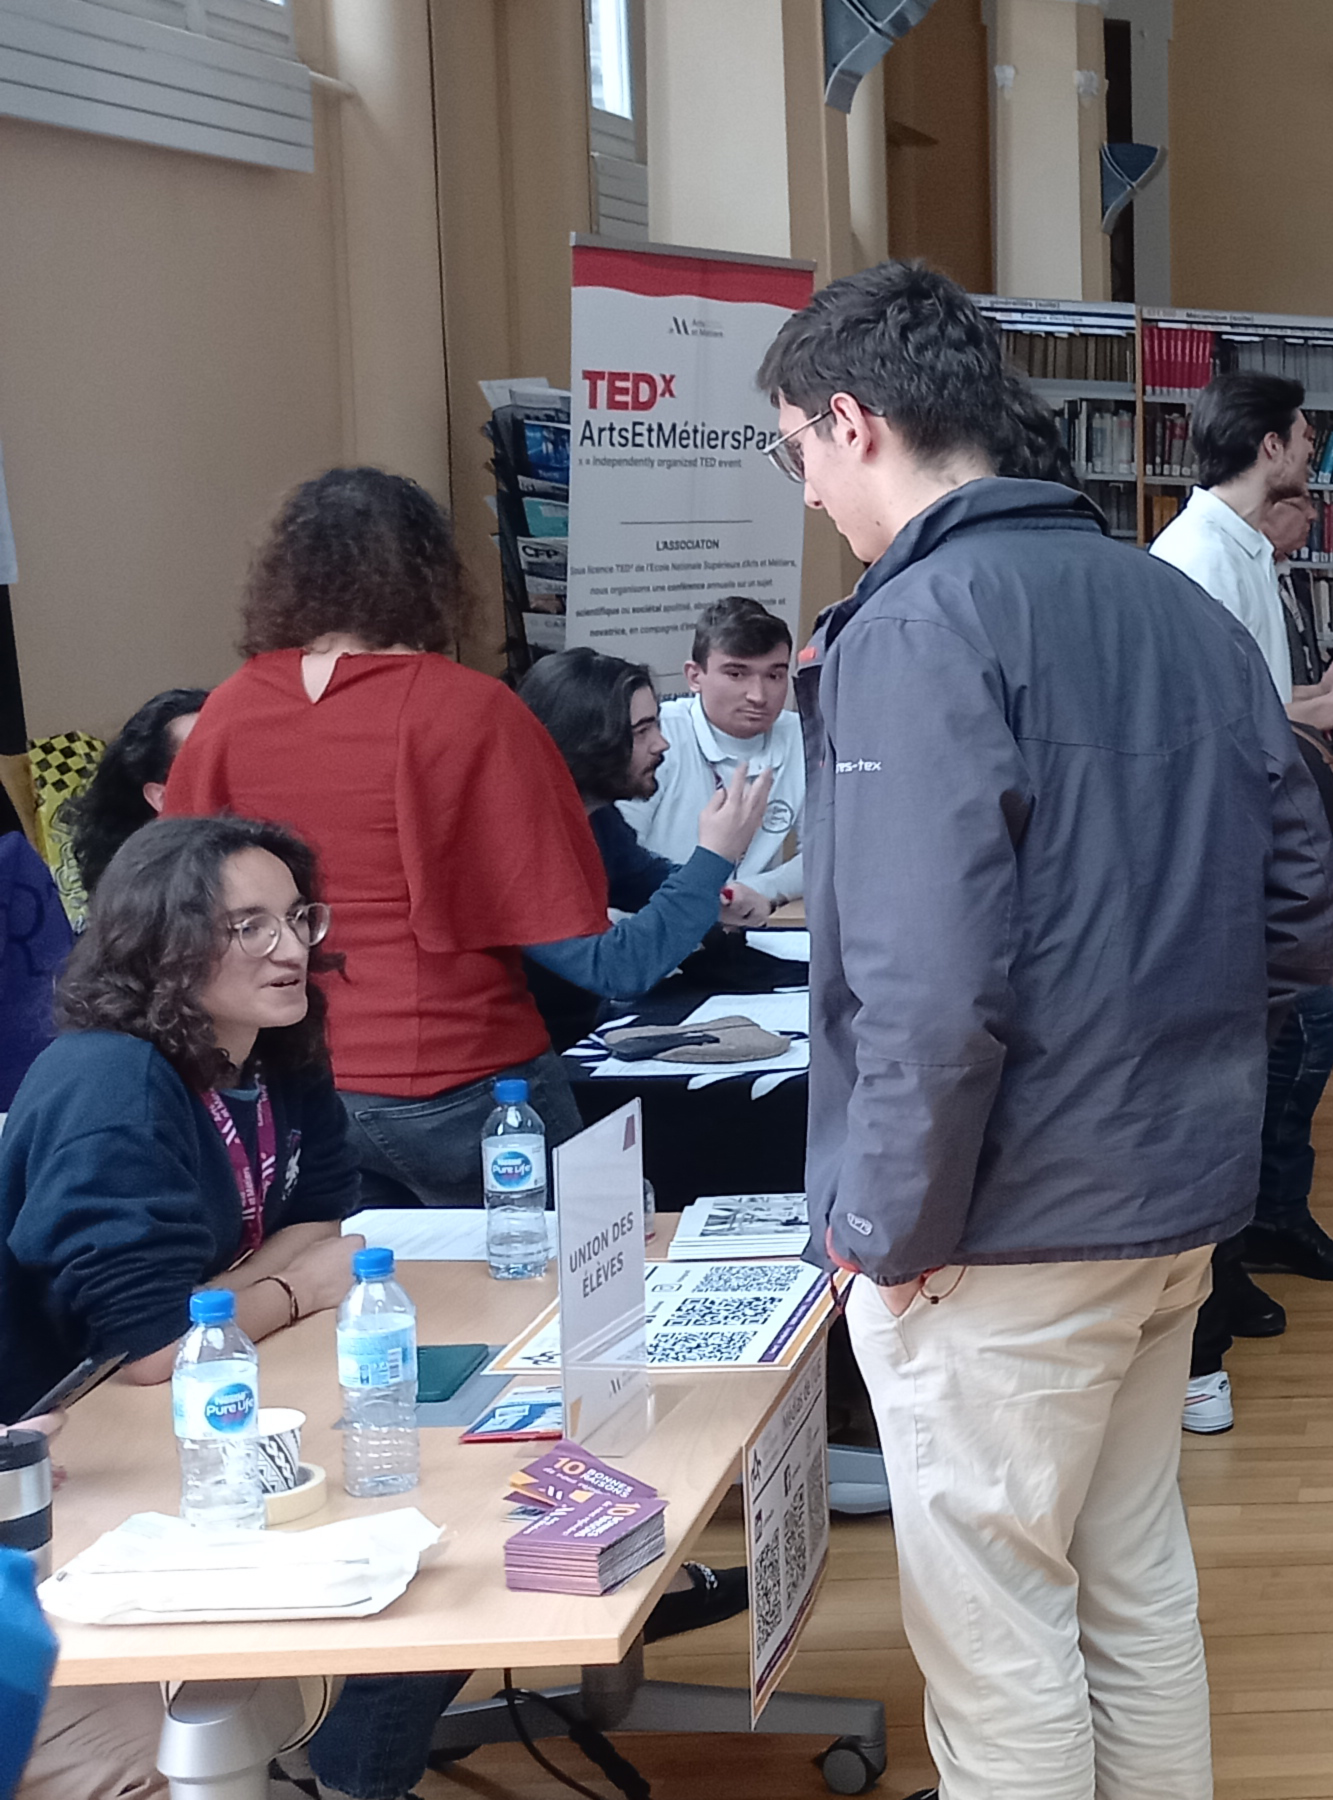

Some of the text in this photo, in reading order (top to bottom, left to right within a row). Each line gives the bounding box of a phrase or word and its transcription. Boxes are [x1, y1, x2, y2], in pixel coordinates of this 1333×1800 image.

[579, 419, 778, 451] ArtsEtMétiersPar
[592, 456, 655, 469] independently
[699, 457, 716, 467] TED
[718, 459, 741, 468] event
[493, 1163, 531, 1176] Pure Life
[569, 1211, 634, 1273] UNION DES
[582, 1250, 624, 1298] ÉLÈVES
[207, 1403, 236, 1416] Pure
[554, 1457, 586, 1475] 10
[581, 1475, 629, 1498] RAISONS
[585, 1468, 634, 1493] BONNES
[607, 1502, 641, 1516] 10
